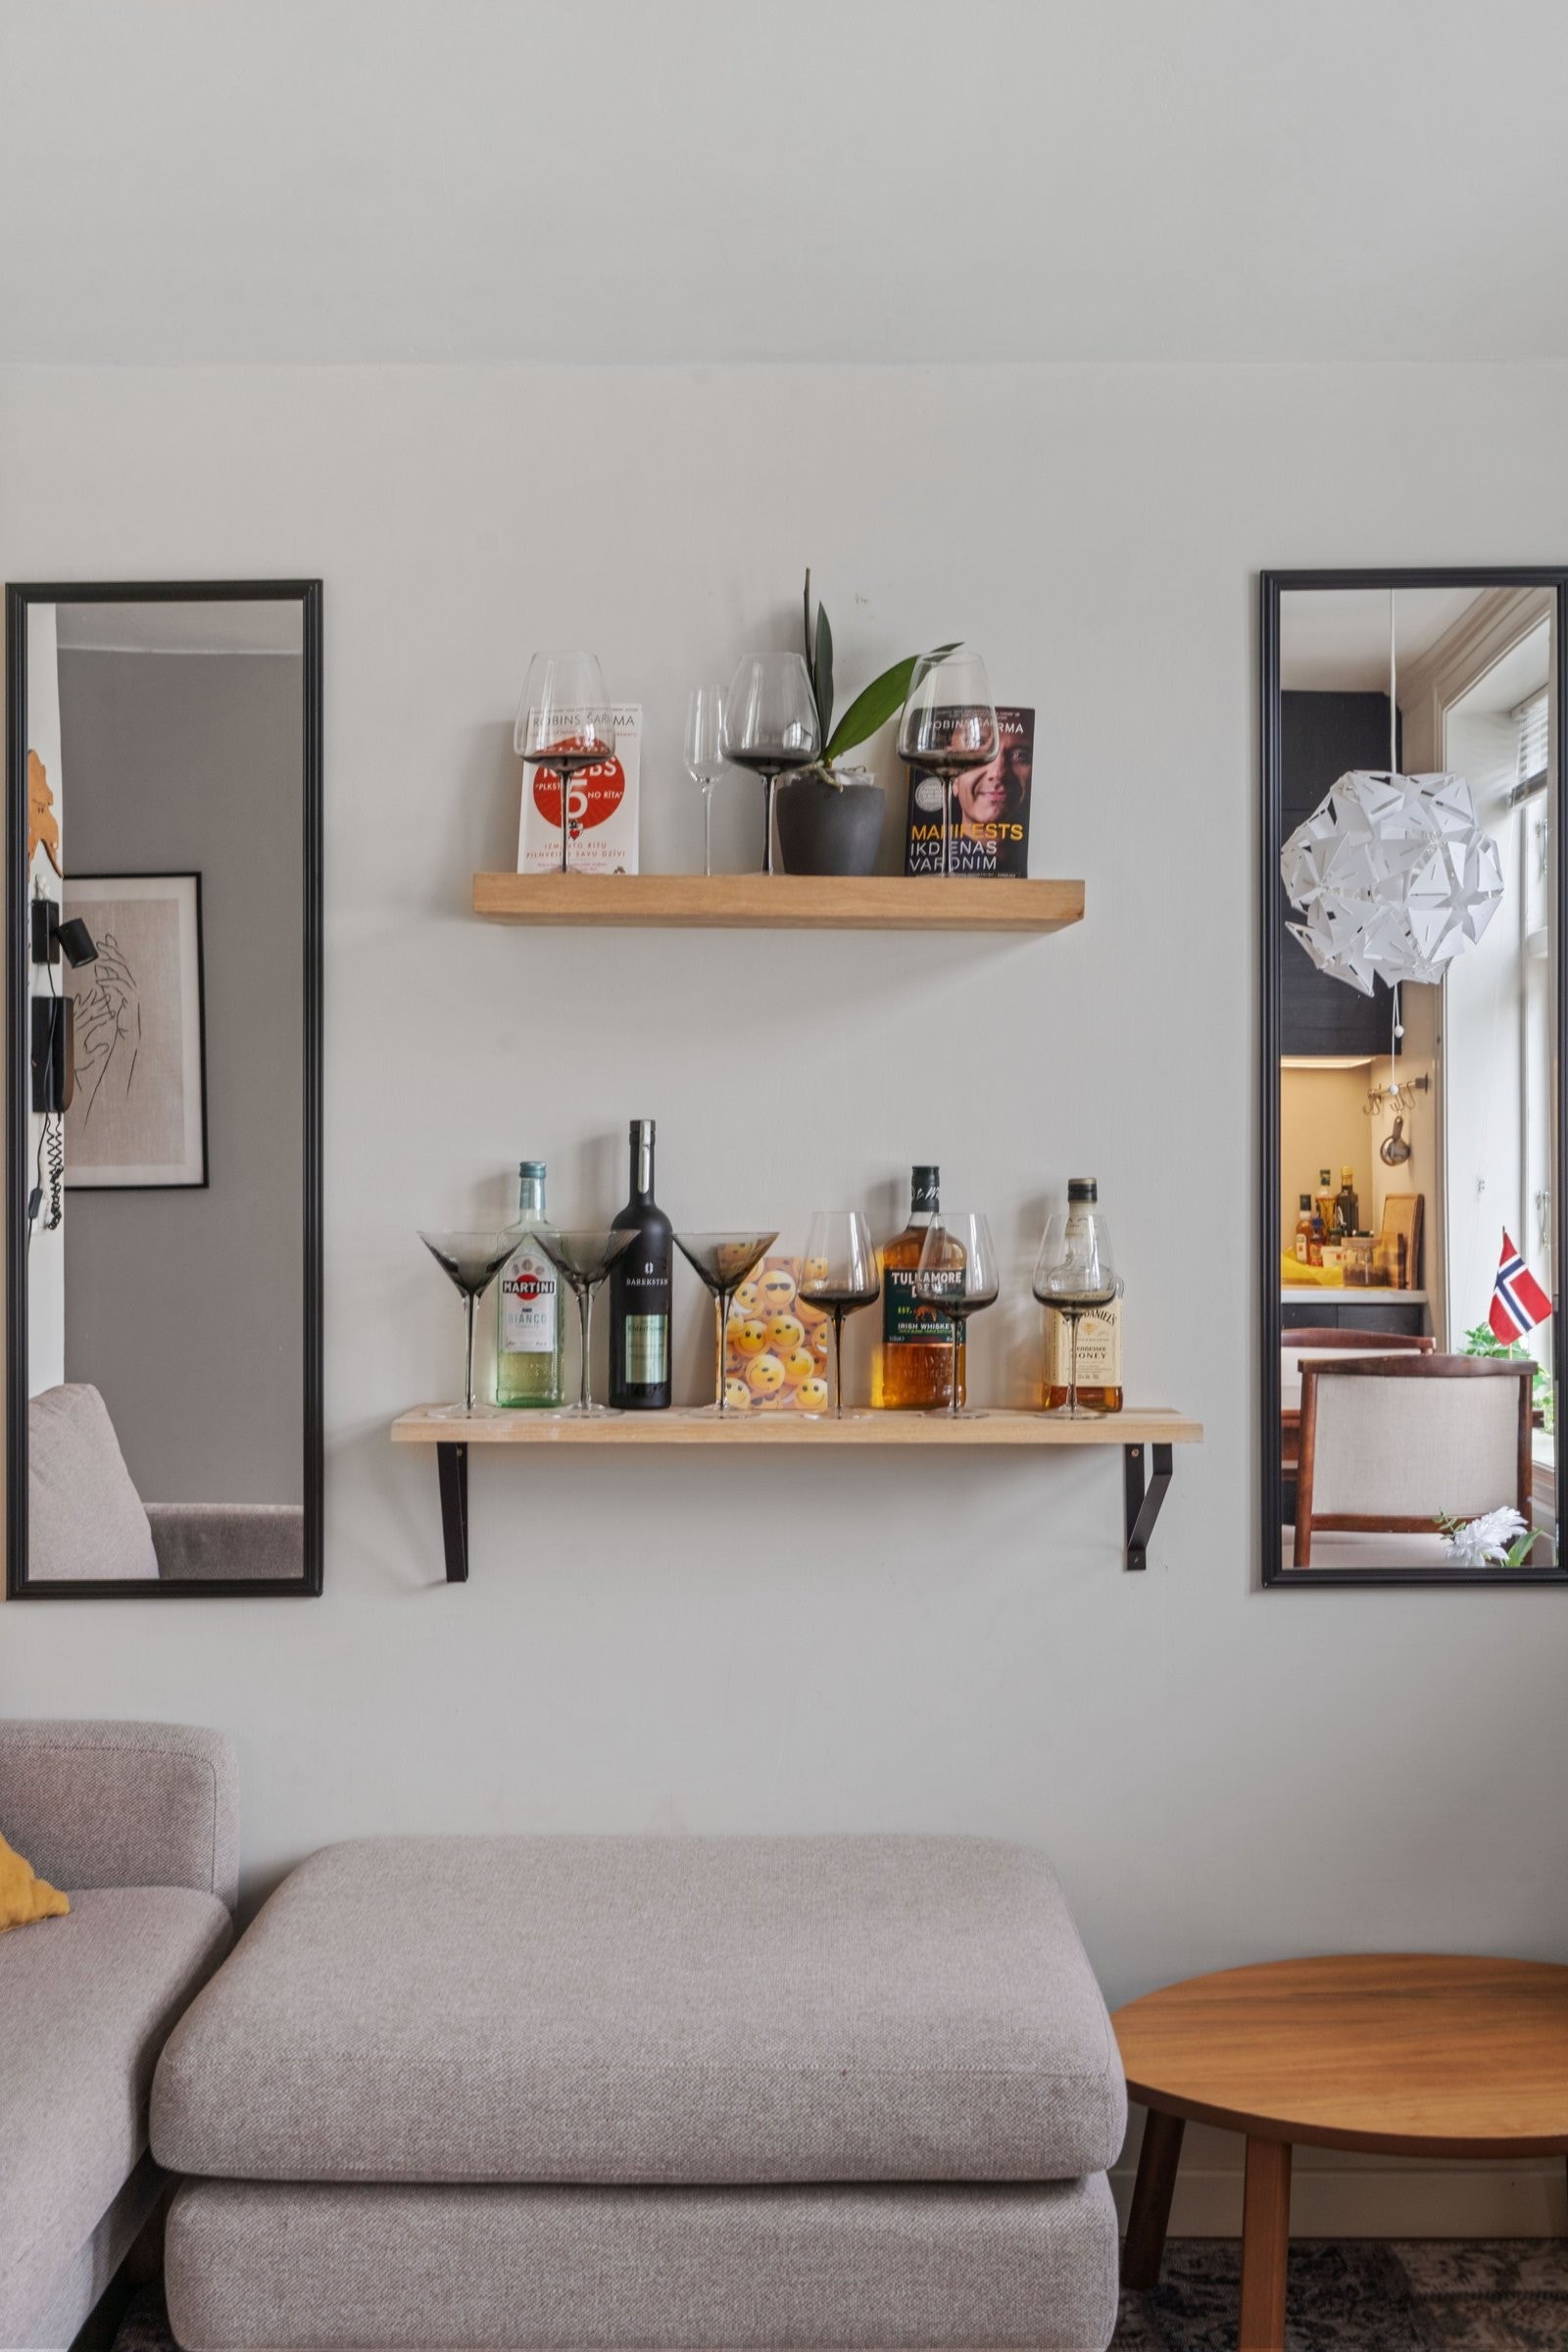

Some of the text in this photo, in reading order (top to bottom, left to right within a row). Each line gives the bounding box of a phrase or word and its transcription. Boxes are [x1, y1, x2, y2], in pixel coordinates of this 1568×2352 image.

[543, 760, 617, 779] KUBS
[567, 778, 588, 819] 5
[910, 841, 998, 857] IKDENAS
[891, 1271, 962, 1286] TULLAMORE
[504, 1281, 555, 1293] MARTINI
[508, 1313, 547, 1324] BIANCO
